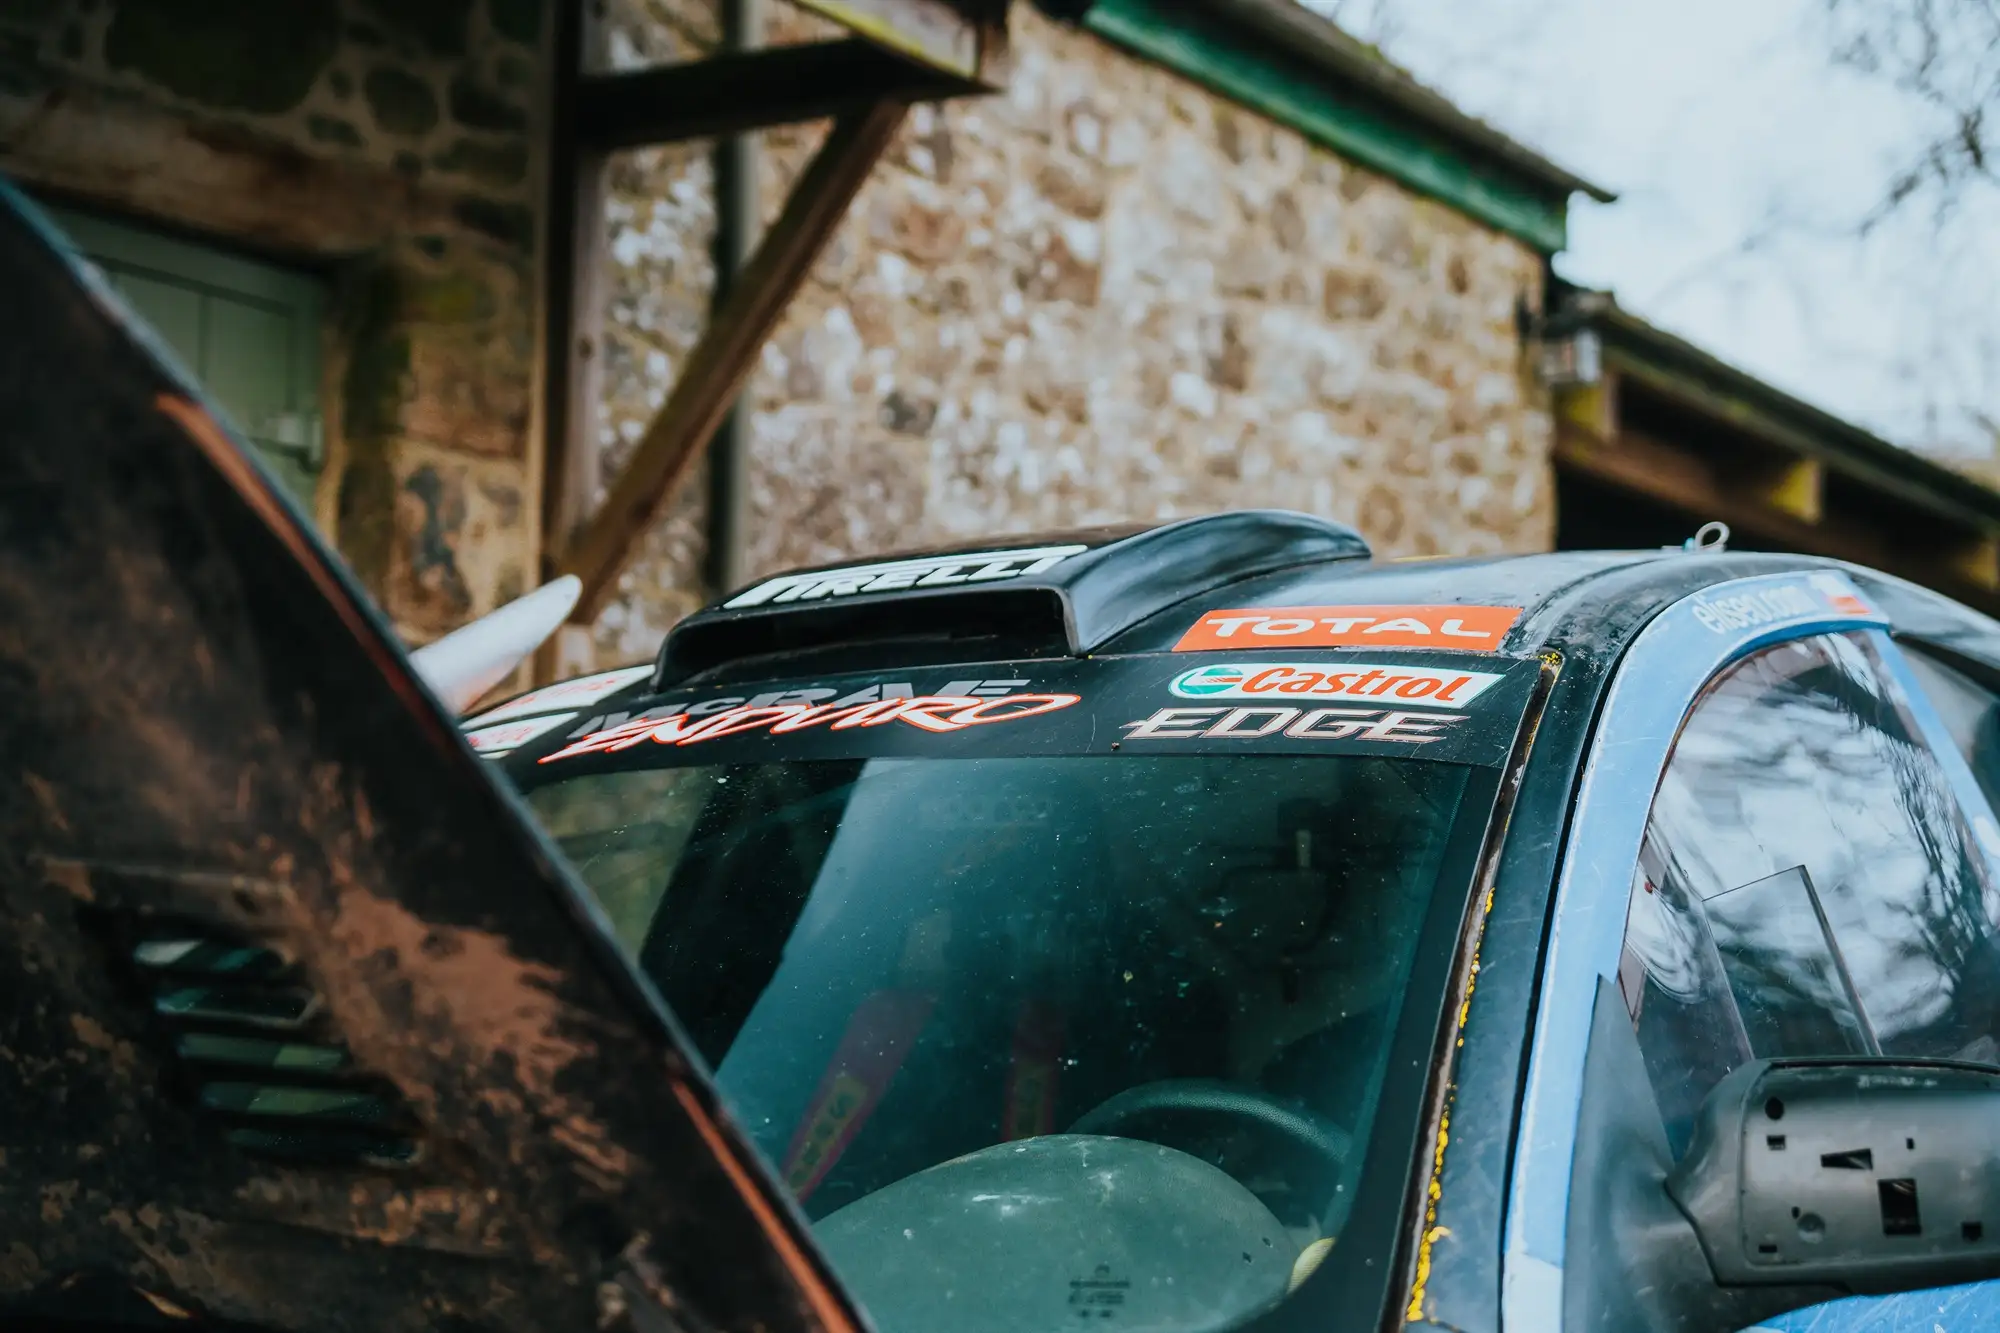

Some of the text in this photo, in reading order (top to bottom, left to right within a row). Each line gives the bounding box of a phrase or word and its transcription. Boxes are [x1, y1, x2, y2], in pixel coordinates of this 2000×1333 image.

[723, 545, 1088, 609] PIRELLI
[1206, 616, 1492, 638] TOTAL
[1241, 667, 1473, 702] Castrol
[538, 694, 1081, 763] ENDURO
[1119, 706, 1471, 744] EDGE
